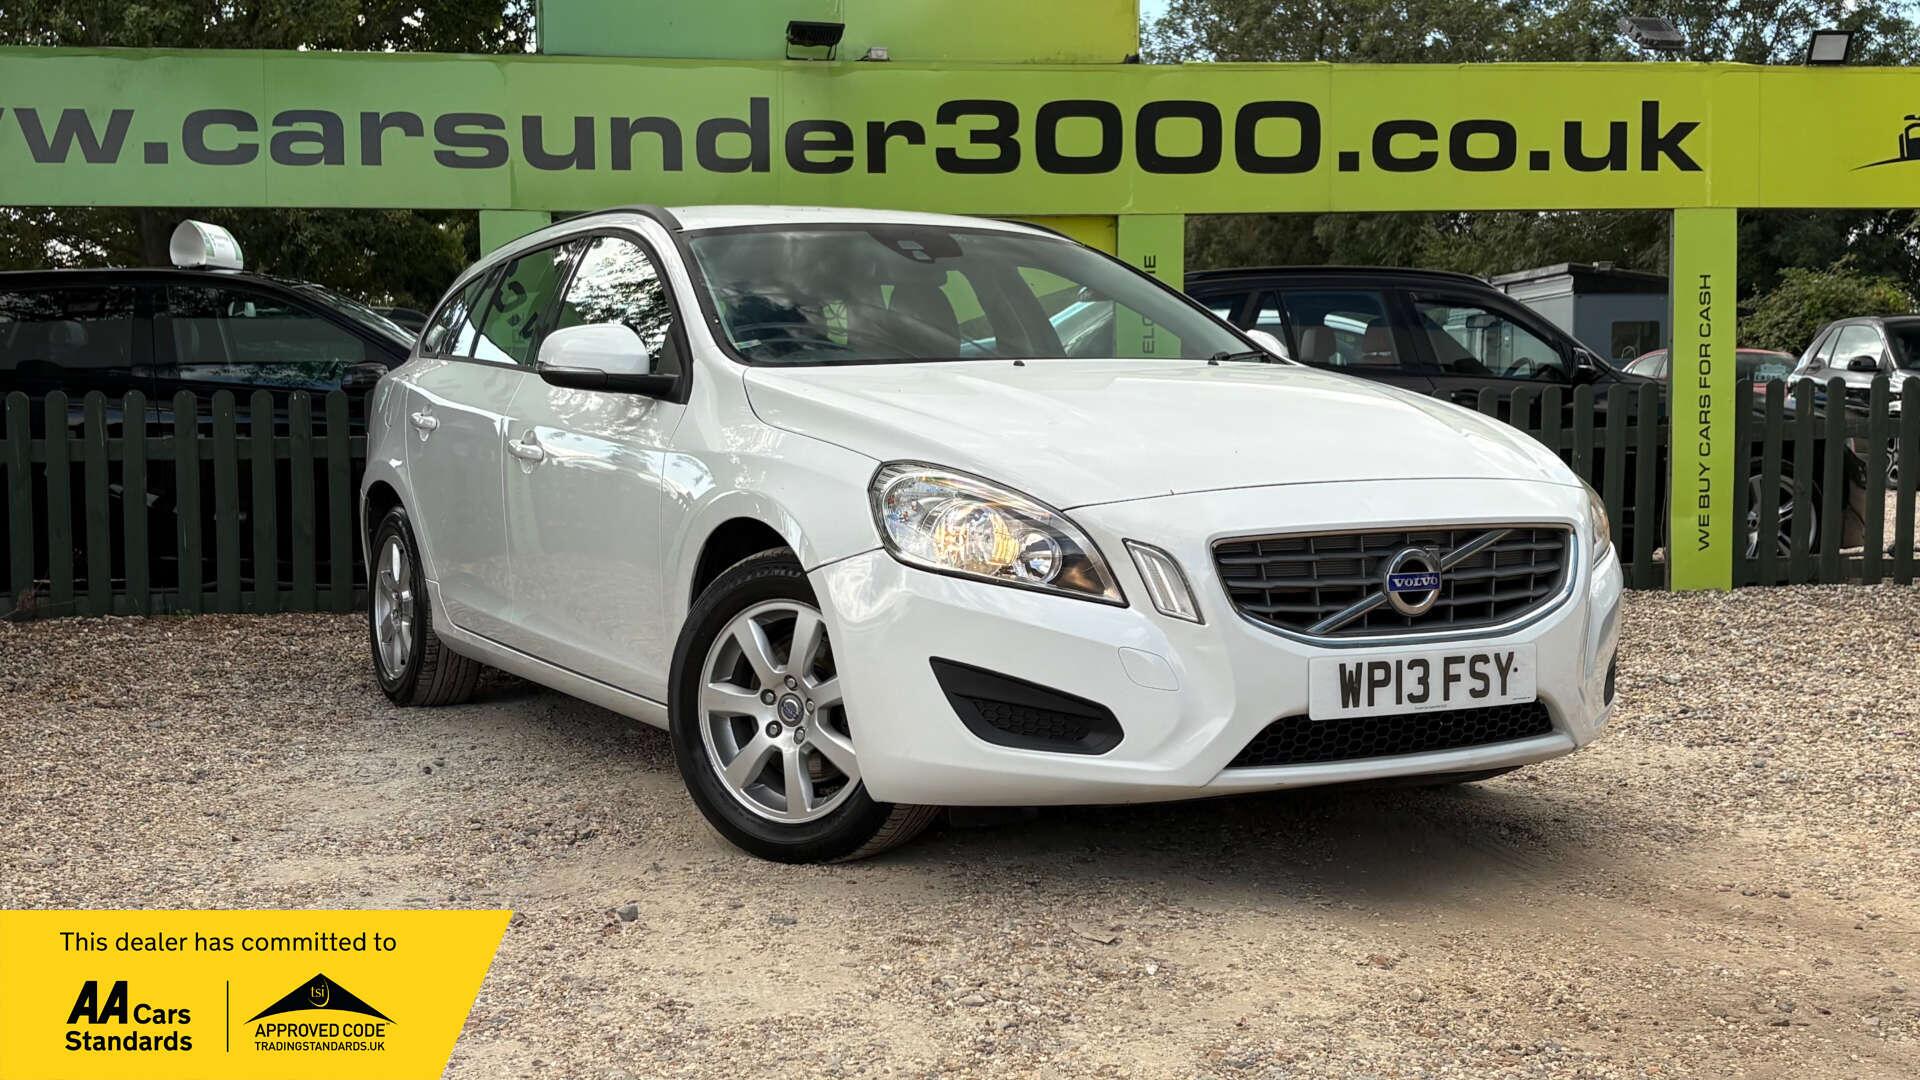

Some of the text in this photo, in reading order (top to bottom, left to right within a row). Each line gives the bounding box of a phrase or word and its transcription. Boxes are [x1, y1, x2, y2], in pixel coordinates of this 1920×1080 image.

[0, 97, 1703, 175] w.carsunder3000.co.uk
[1698, 274, 1711, 551] WE BUY CARS FOR CASH
[1392, 576, 1438, 587] VOLVO
[1339, 651, 1514, 709] WP13 FSY
